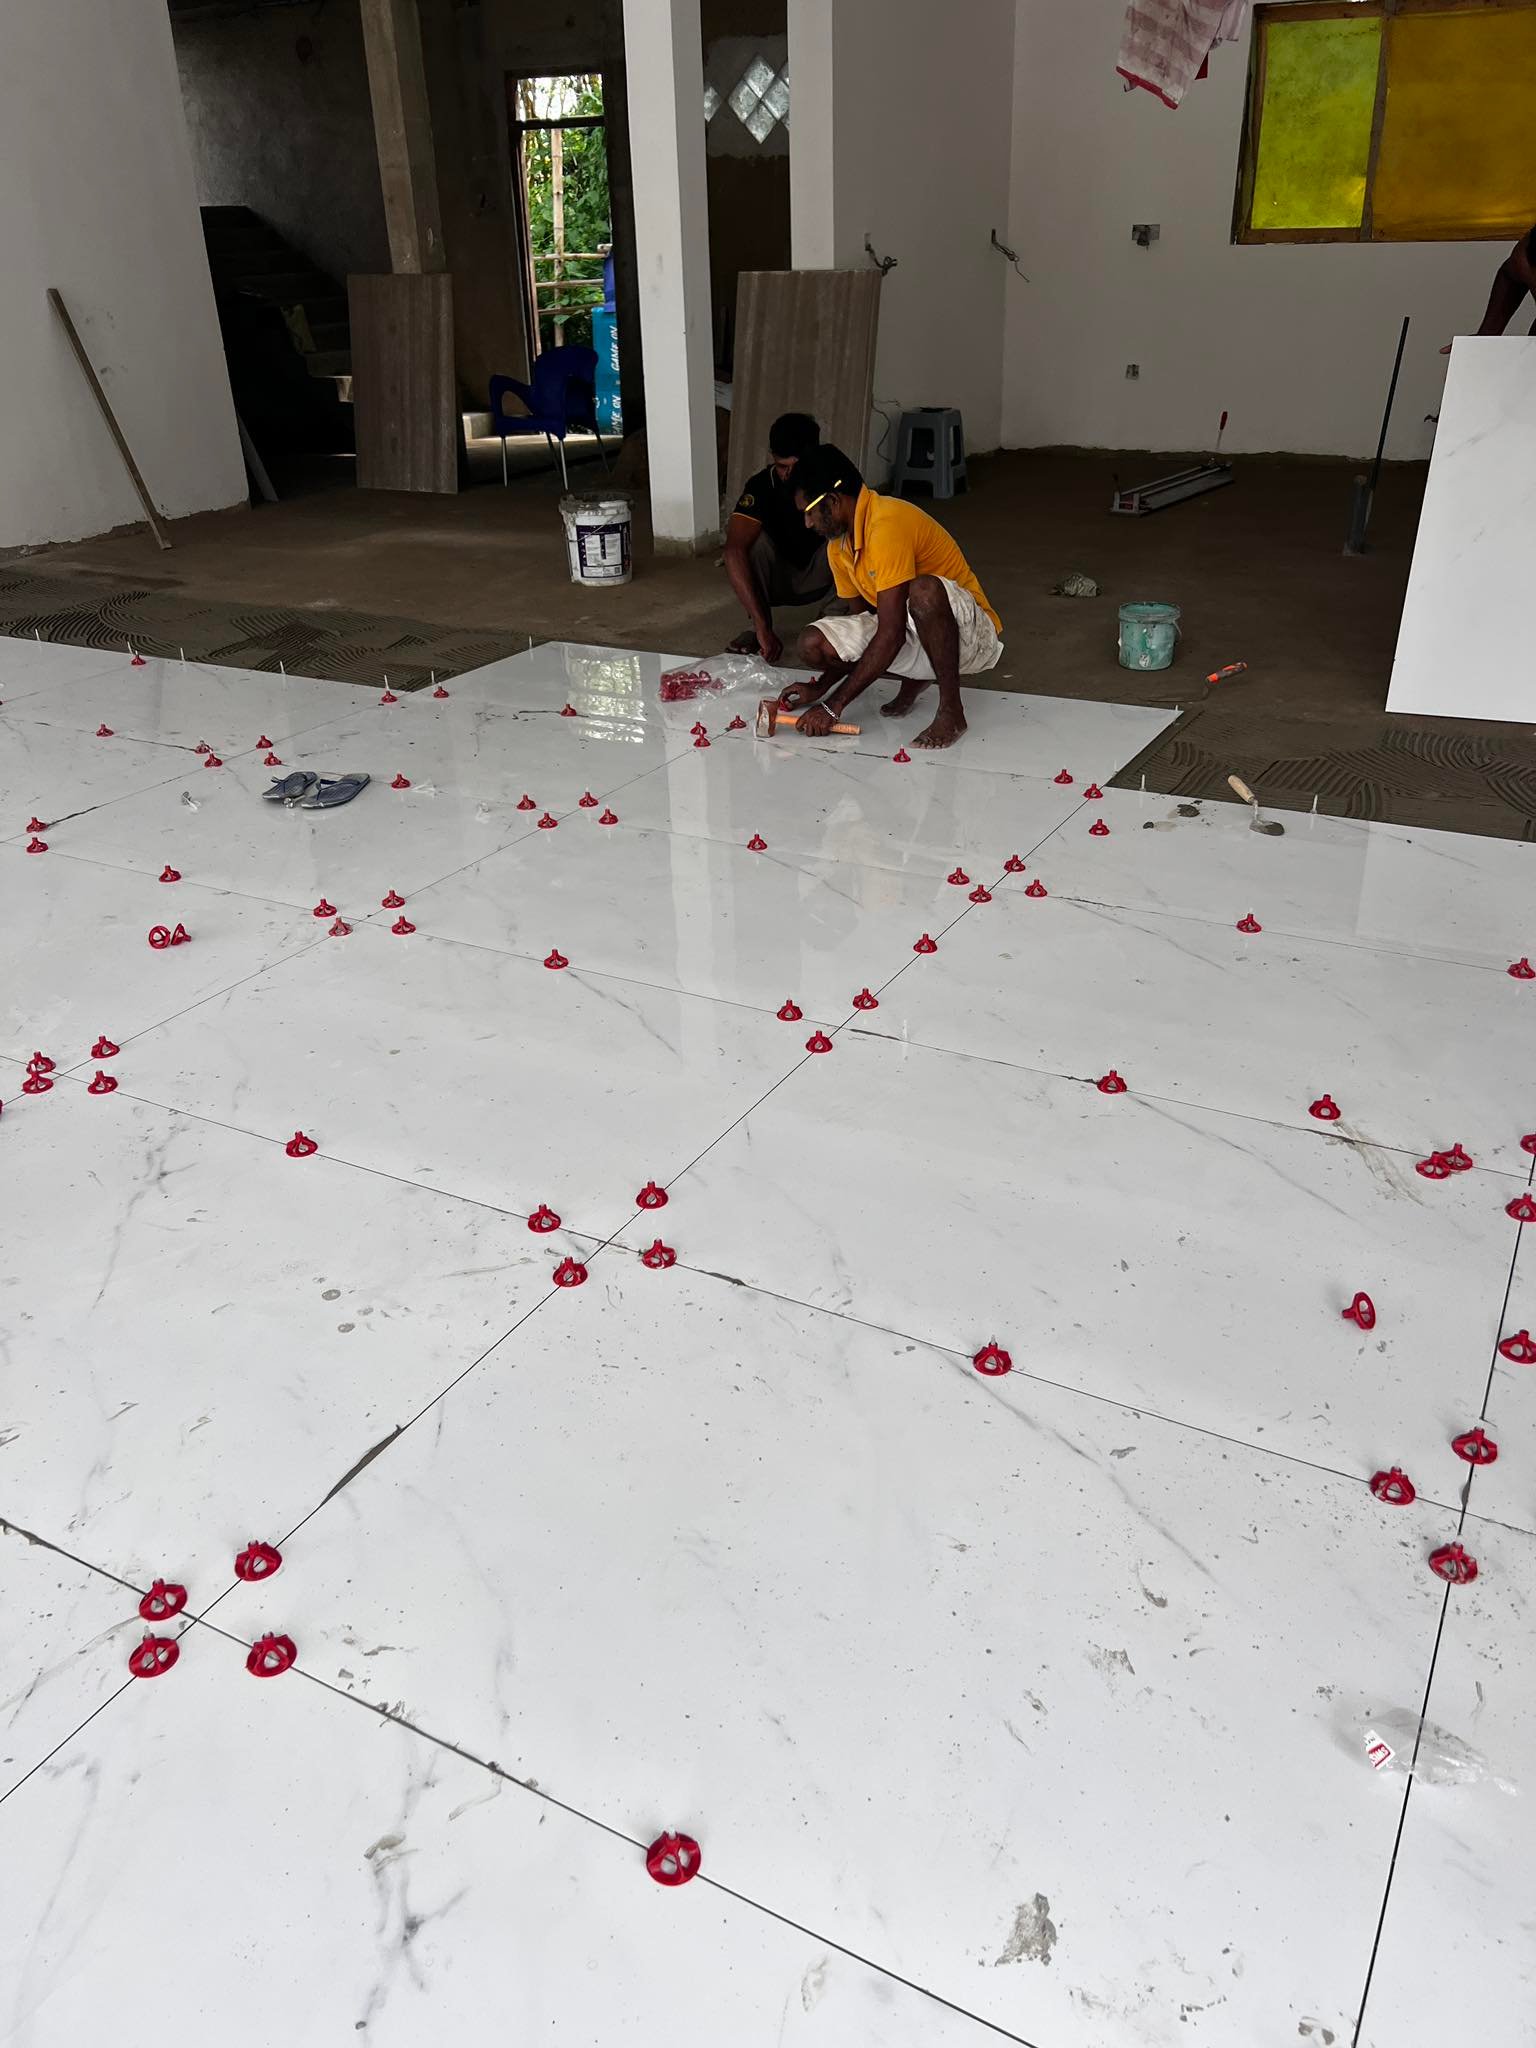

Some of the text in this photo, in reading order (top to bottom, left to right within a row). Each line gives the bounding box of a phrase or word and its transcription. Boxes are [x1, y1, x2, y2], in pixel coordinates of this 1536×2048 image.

[609, 325, 620, 371] GAME ON
[612, 394, 622, 409] ON
